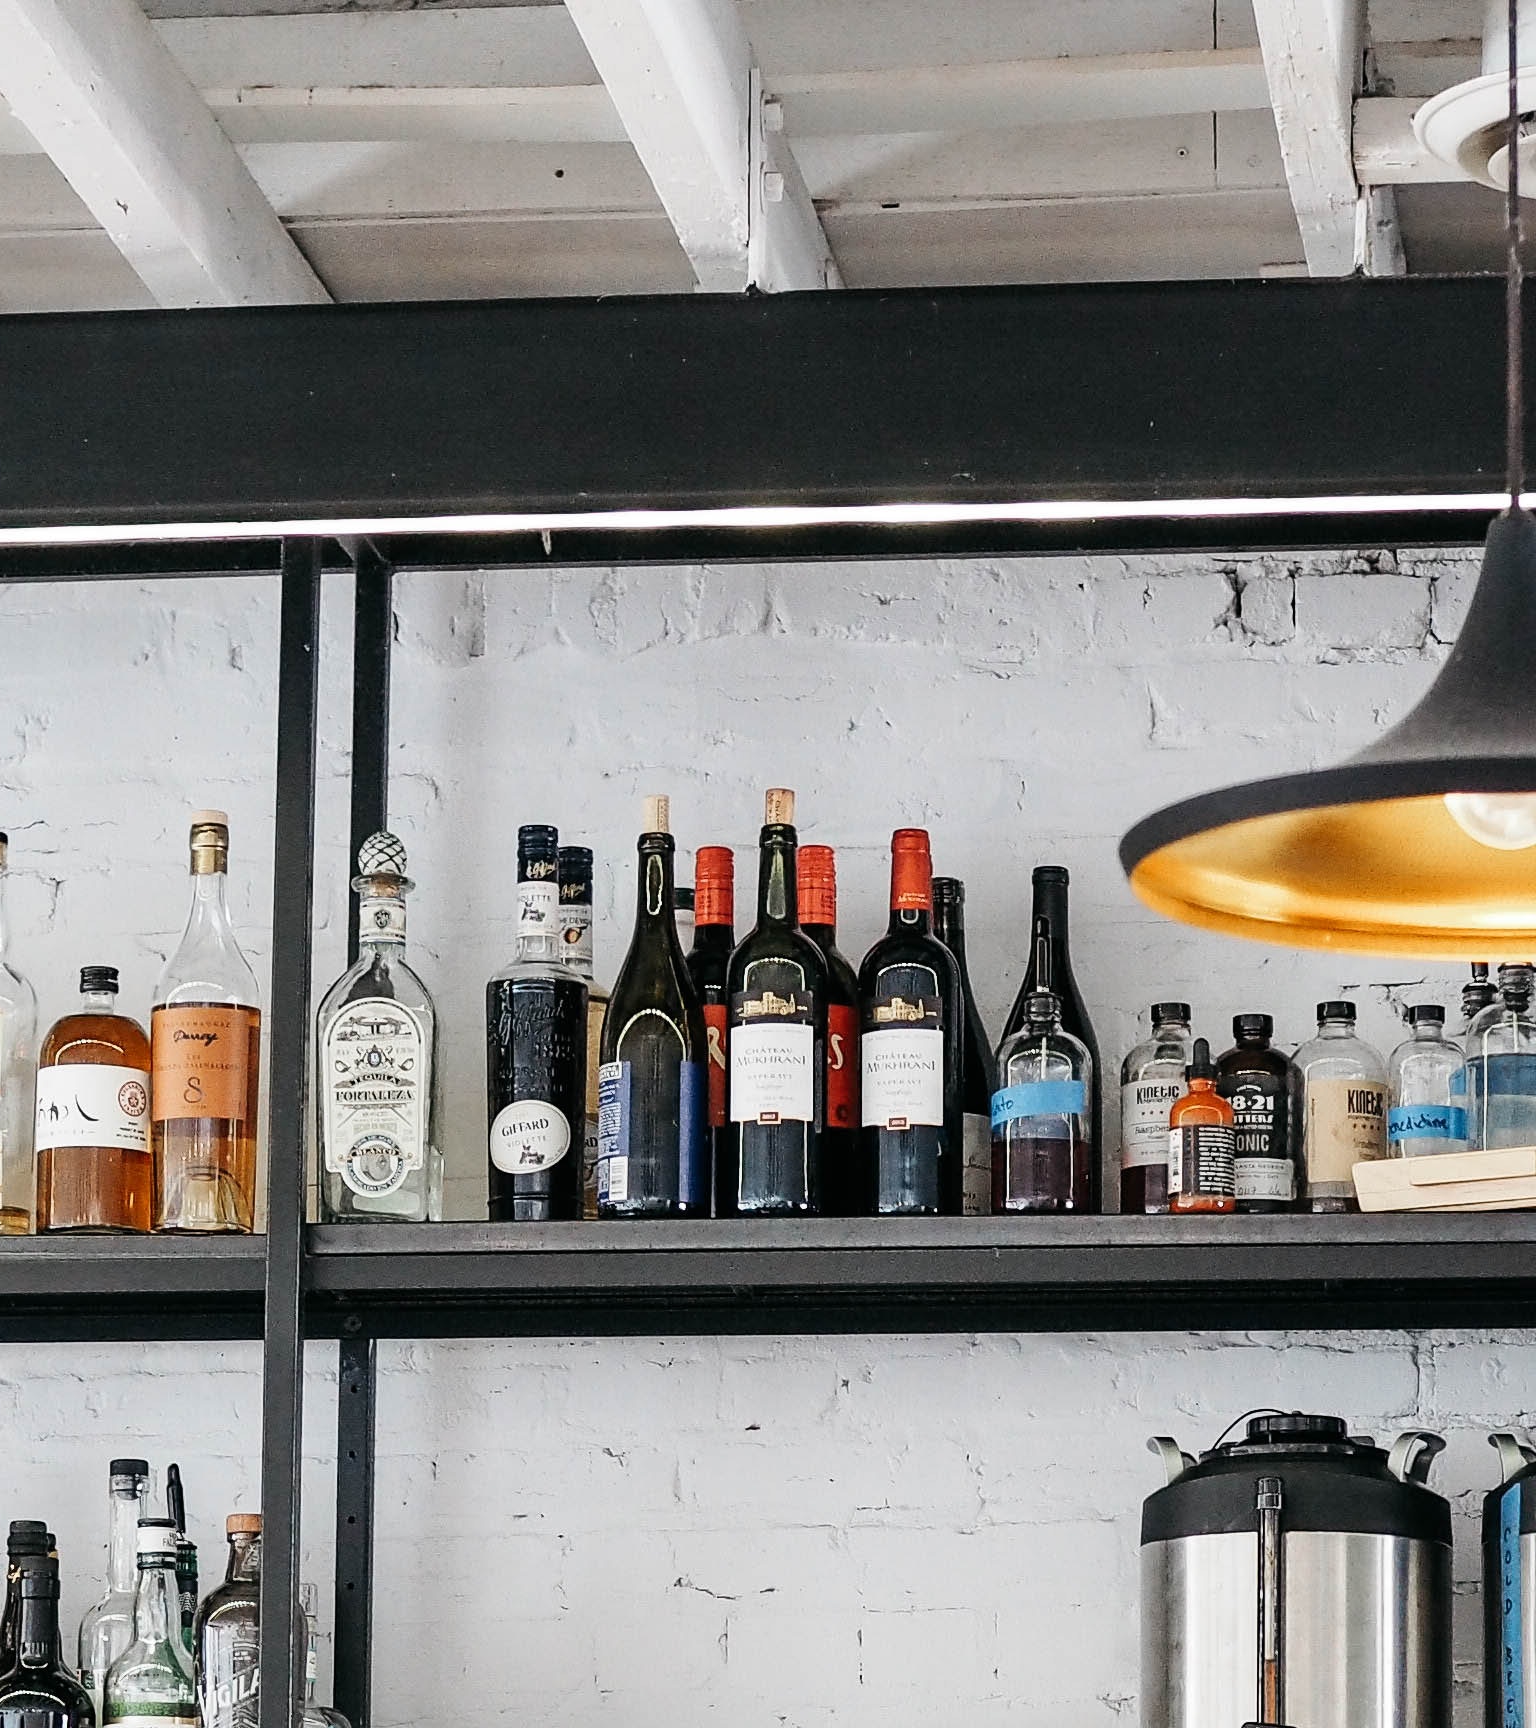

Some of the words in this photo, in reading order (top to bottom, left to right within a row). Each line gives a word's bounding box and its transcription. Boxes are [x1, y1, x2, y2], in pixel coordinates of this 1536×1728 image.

[866, 1061, 937, 1074] MUKHRANI
[336, 1089, 414, 1102] FORTALEZA
[1233, 1114, 1274, 1124] ITTERS
[501, 1116, 550, 1138] GIFFARD
[1236, 1134, 1270, 1152] ONIC
